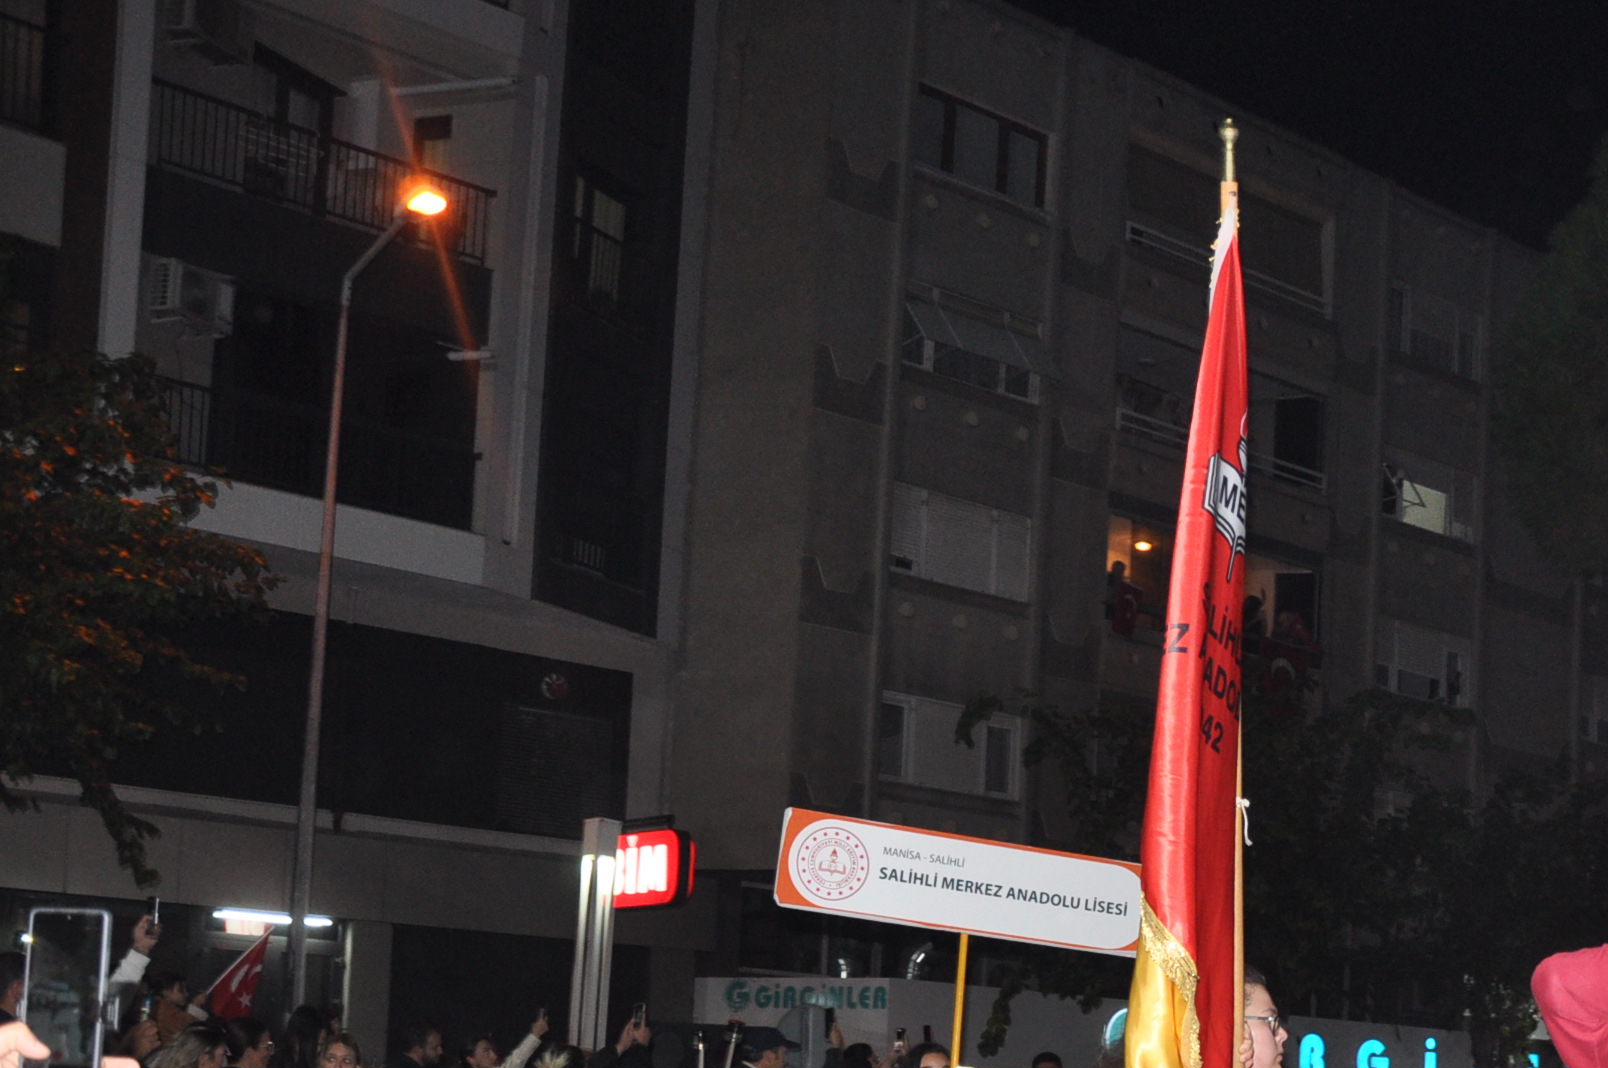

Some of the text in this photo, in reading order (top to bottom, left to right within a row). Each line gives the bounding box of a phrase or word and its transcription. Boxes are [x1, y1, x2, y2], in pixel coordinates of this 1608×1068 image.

[1219, 475, 1247, 525] ME
[883, 846, 921, 861] MANİSA
[929, 853, 965, 868] SALİHLİ
[878, 866, 1128, 916] SALİHLİ MERKEZ ANADOLU LİSESİ
